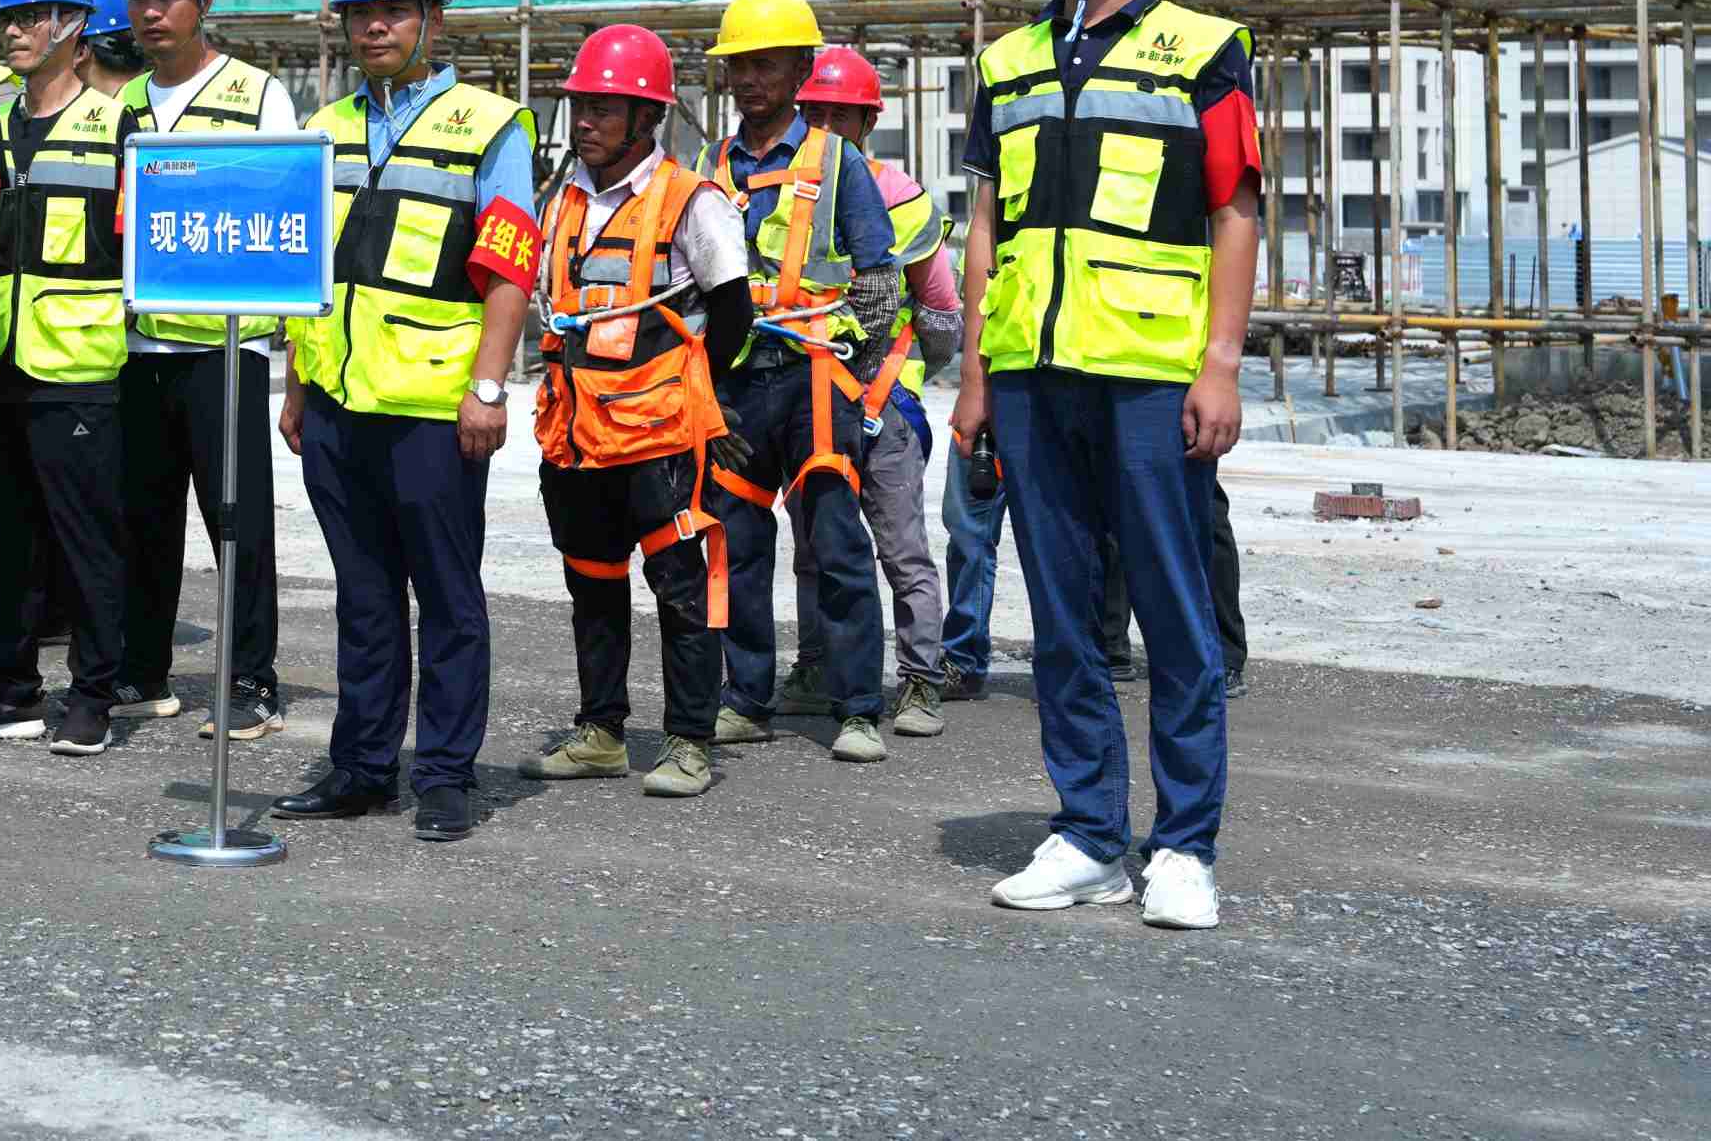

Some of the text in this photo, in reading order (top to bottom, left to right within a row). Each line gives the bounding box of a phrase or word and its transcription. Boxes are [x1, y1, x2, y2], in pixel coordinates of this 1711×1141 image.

[150, 211, 309, 254] 现场作业组
